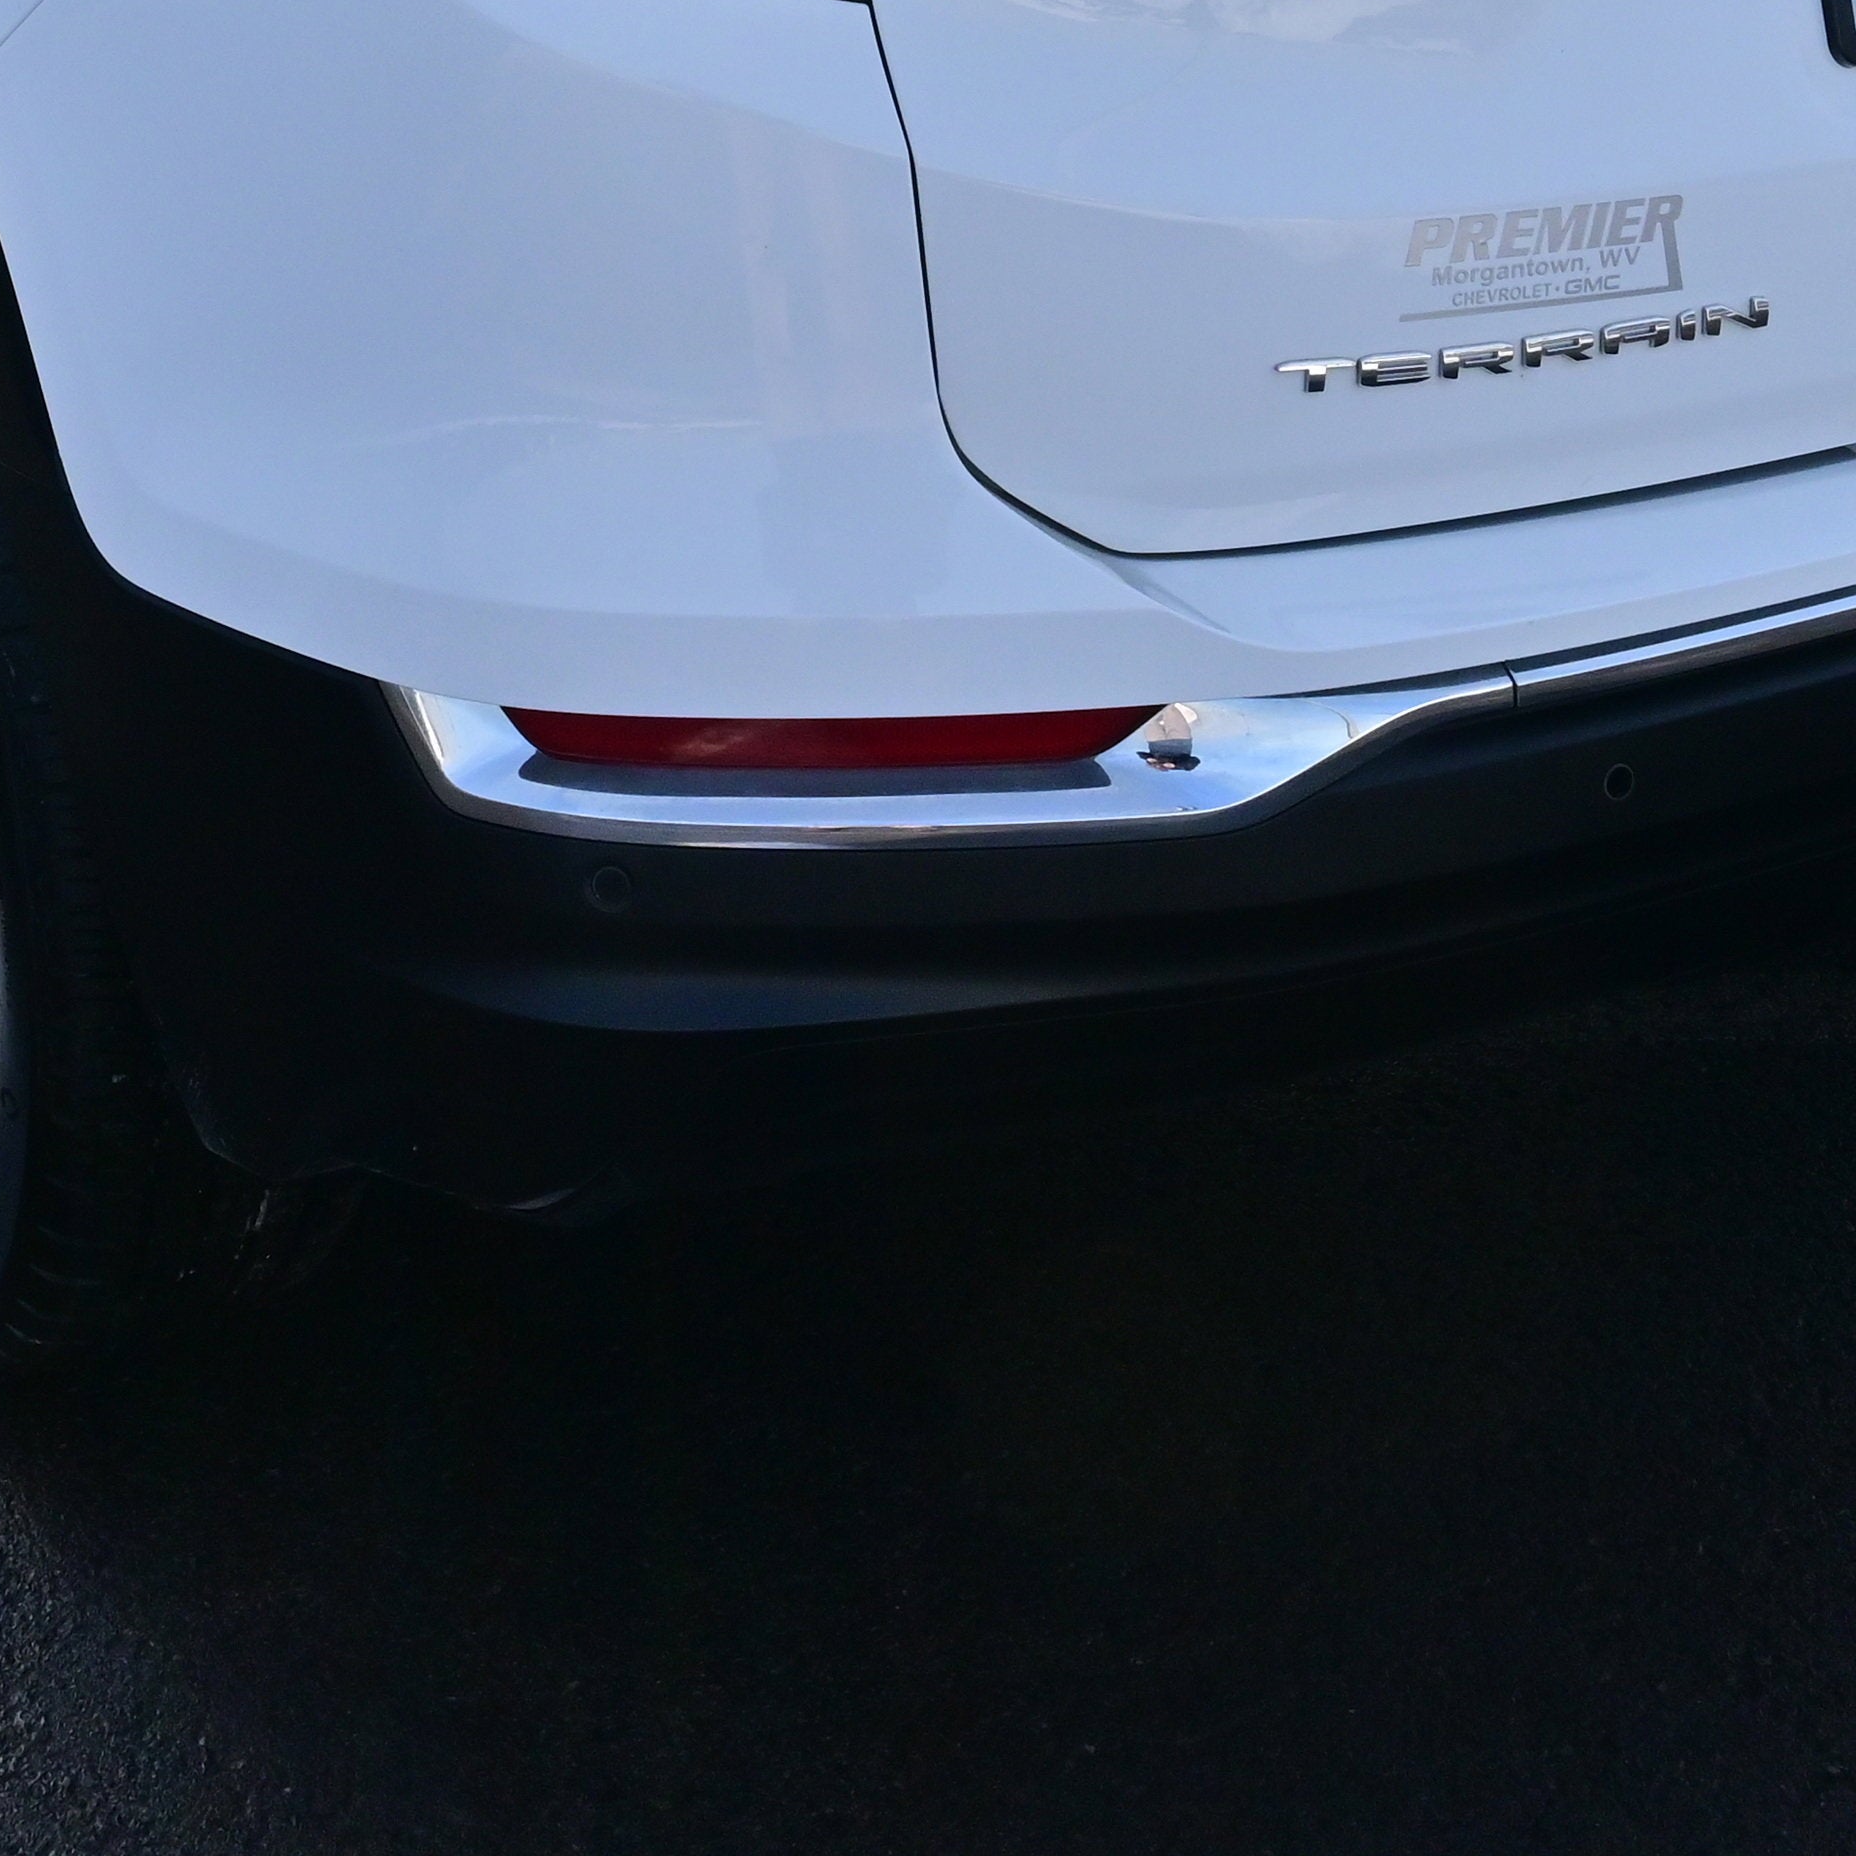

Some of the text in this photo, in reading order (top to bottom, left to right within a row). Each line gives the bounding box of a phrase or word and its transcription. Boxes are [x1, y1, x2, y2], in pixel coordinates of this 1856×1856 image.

[1404, 194, 1684, 268] PREMIER
[1431, 246, 1641, 287] Morgantown, WV
[1451, 275, 1621, 308] CHEVROLET GMC
[1273, 294, 1771, 394] TERRAIN
